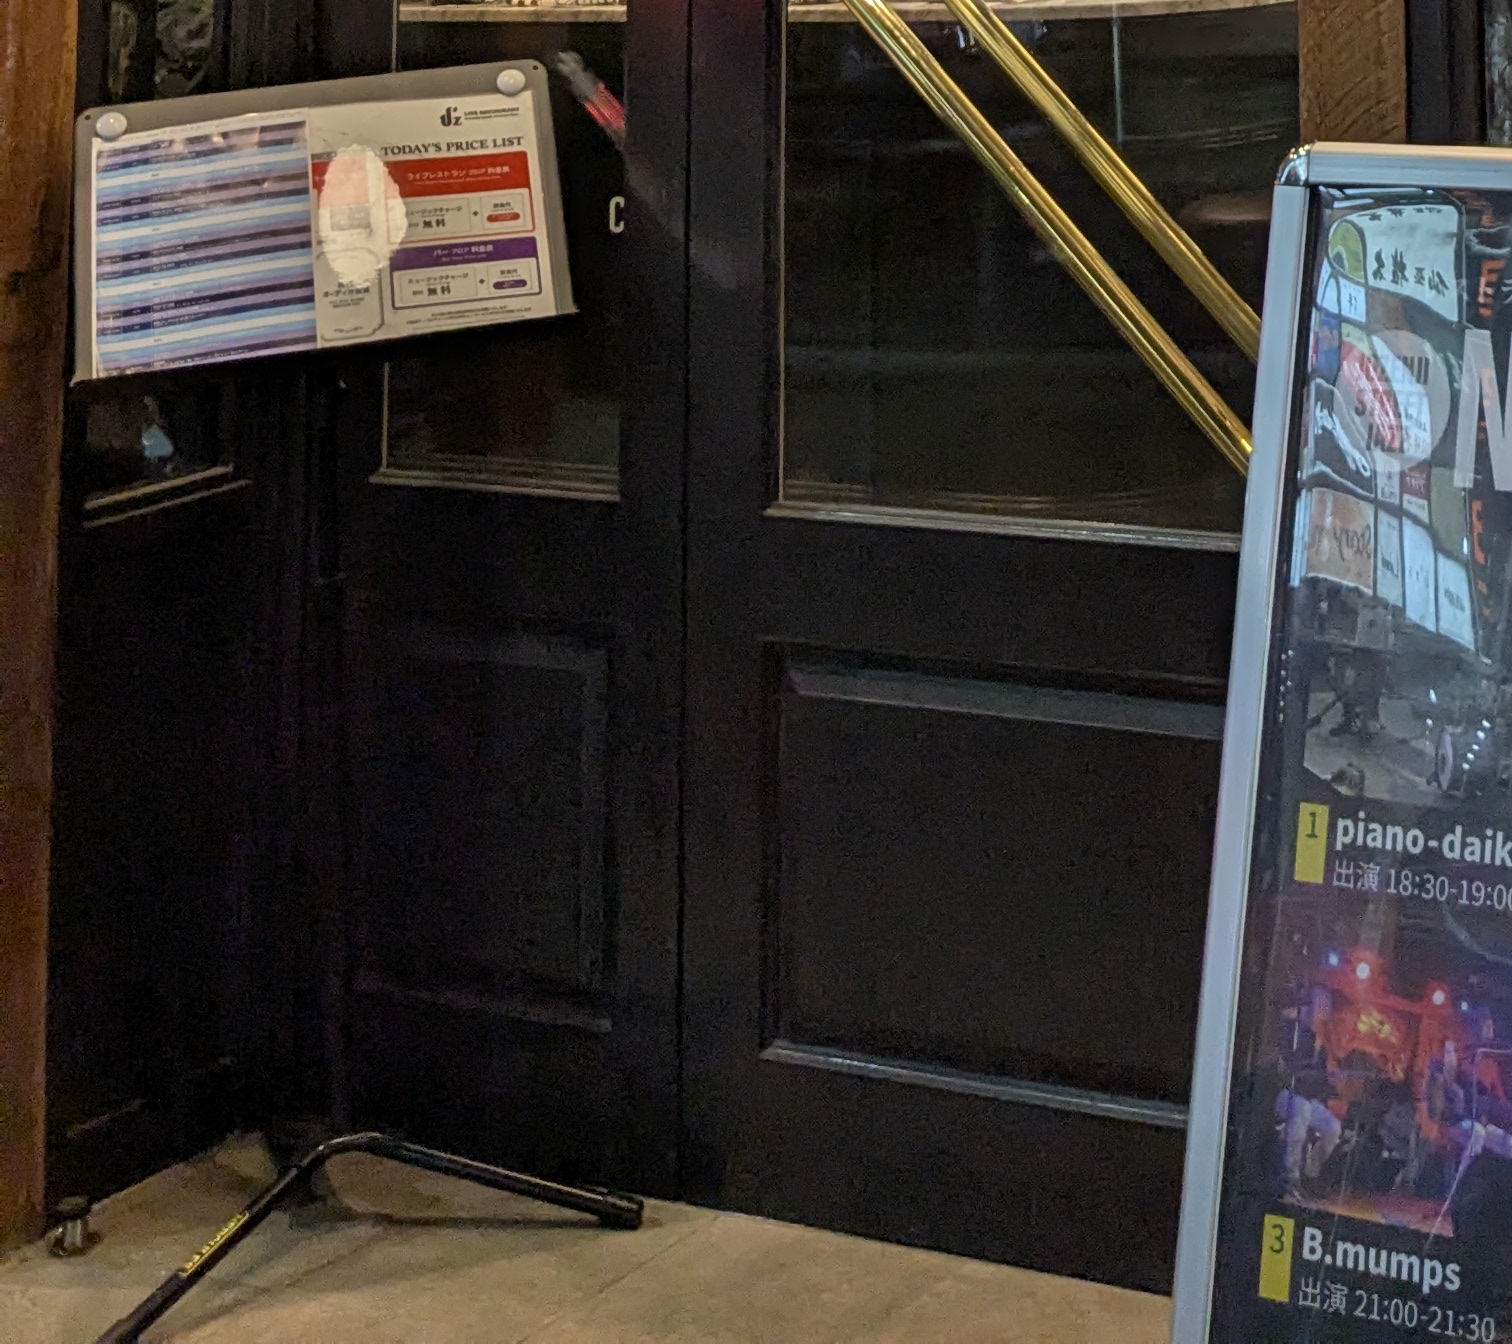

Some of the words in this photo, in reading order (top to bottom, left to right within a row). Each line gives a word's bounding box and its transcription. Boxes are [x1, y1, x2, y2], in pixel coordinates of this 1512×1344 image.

[381, 142, 443, 157] TODAY'S
[446, 139, 489, 153] PRICE
[492, 136, 525, 148] LIST
[1305, 811, 1319, 839] 1
[1332, 858, 1382, 893] 出演
[1270, 1223, 1285, 1254] 3
[1302, 1226, 1462, 1295] B.mumps
[1298, 1276, 1349, 1315] 出演
[1354, 1289, 1496, 1344] 21:00-21:30
